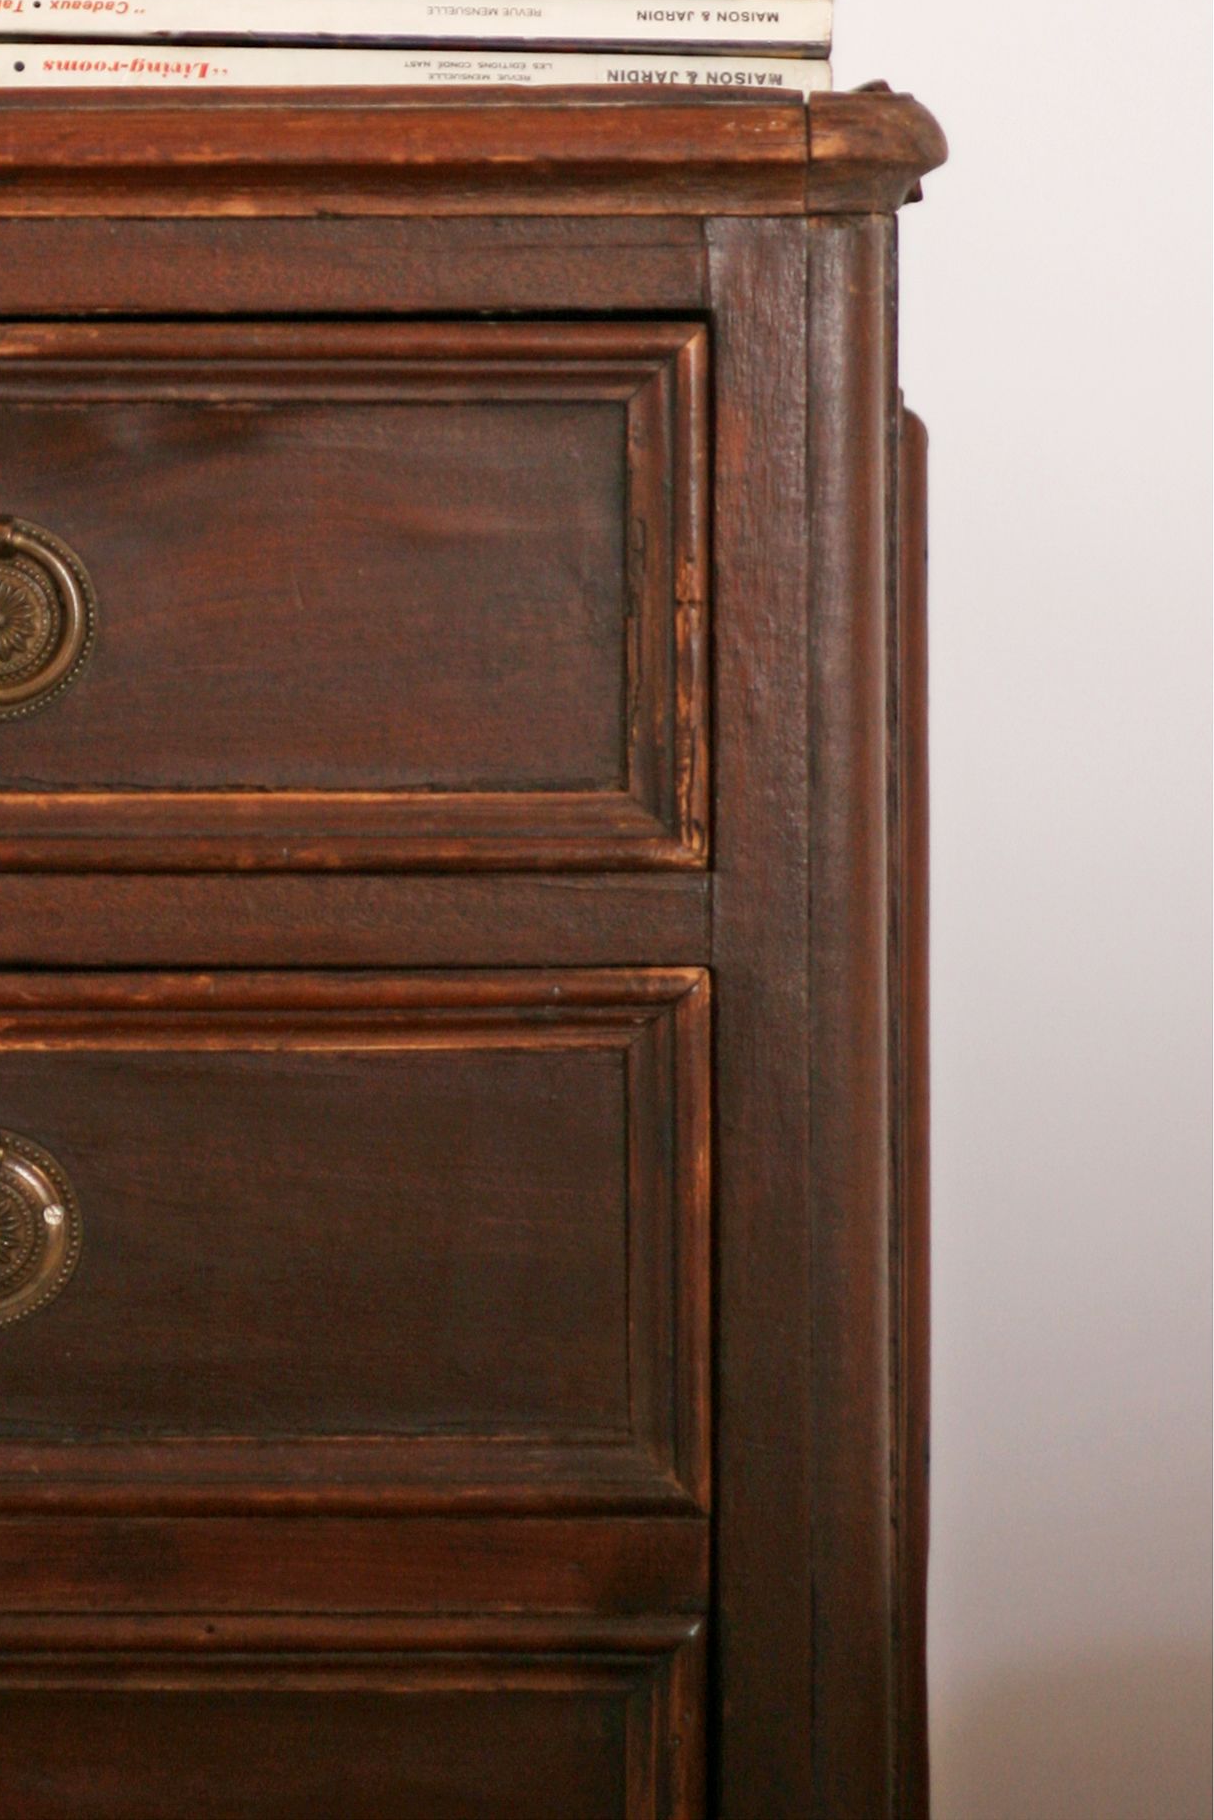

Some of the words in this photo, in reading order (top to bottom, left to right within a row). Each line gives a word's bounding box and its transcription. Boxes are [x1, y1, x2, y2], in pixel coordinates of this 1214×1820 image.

[426, 6, 498, 16] MENSUELLE
[502, 7, 542, 17] REVUE
[636, 10, 694, 21] JARDIN
[701, 11, 710, 21] &
[716, 11, 779, 23] MAISON
[427, 73, 491, 81] MENSUELLE
[497, 73, 531, 81] REVUE
[606, 69, 679, 83] JARDIN
[685, 70, 698, 85] &
[706, 71, 783, 86] MAISON
